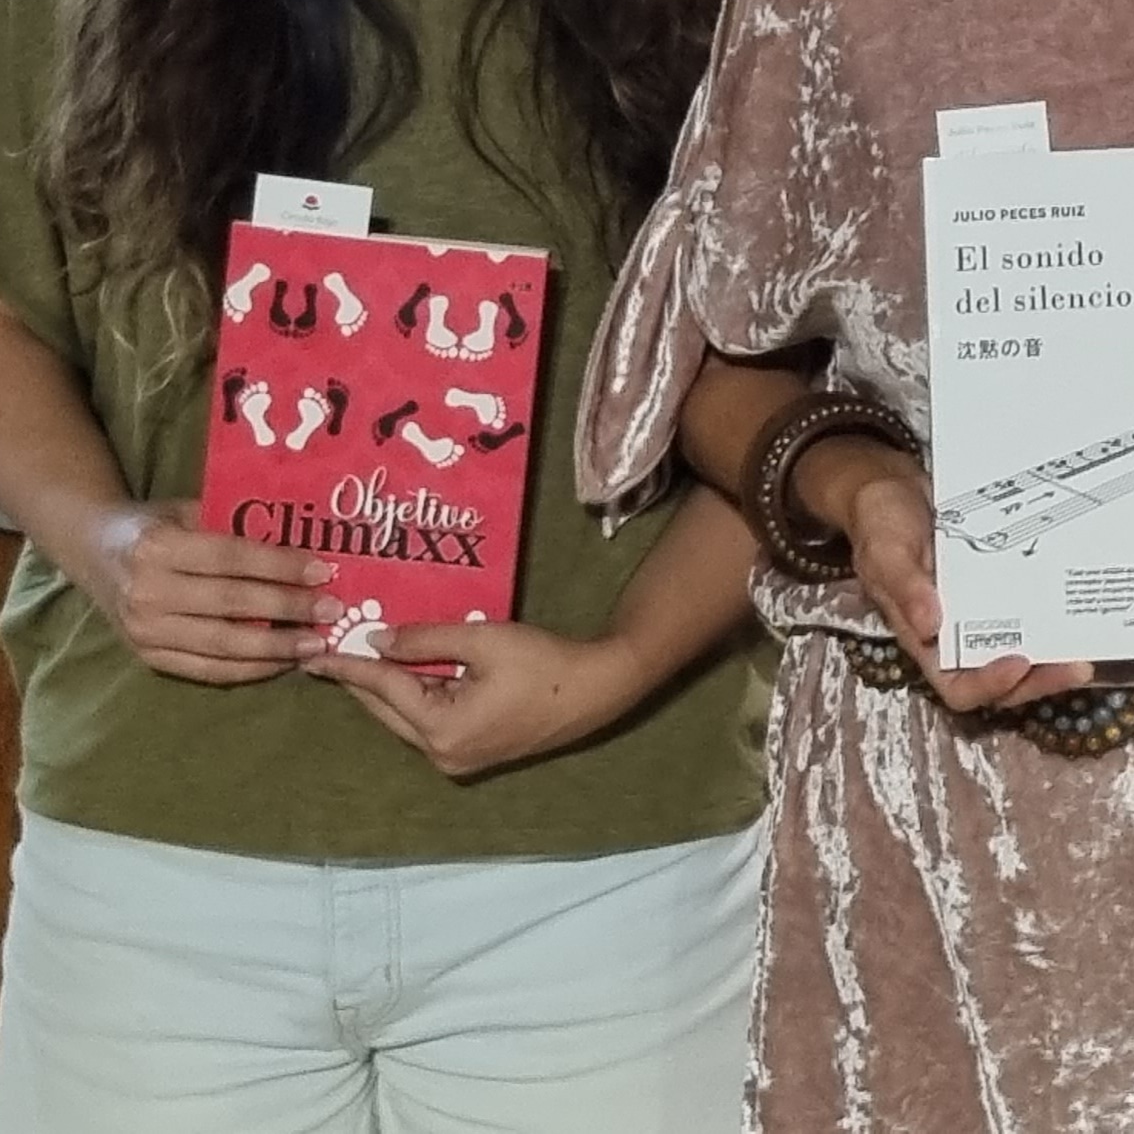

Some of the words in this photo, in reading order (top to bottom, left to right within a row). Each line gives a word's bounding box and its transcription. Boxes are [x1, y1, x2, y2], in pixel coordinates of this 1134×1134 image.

[952, 209, 996, 223] JULIO
[1000, 207, 1047, 221] PECES
[1051, 205, 1086, 218] RUIZ
[955, 245, 988, 272] El
[1001, 241, 1104, 270] sonido
[955, 286, 1002, 314] del
[1013, 282, 1133, 313] silencio
[330, 465, 484, 552] Objetivo
[231, 498, 486, 568] Climaxx
